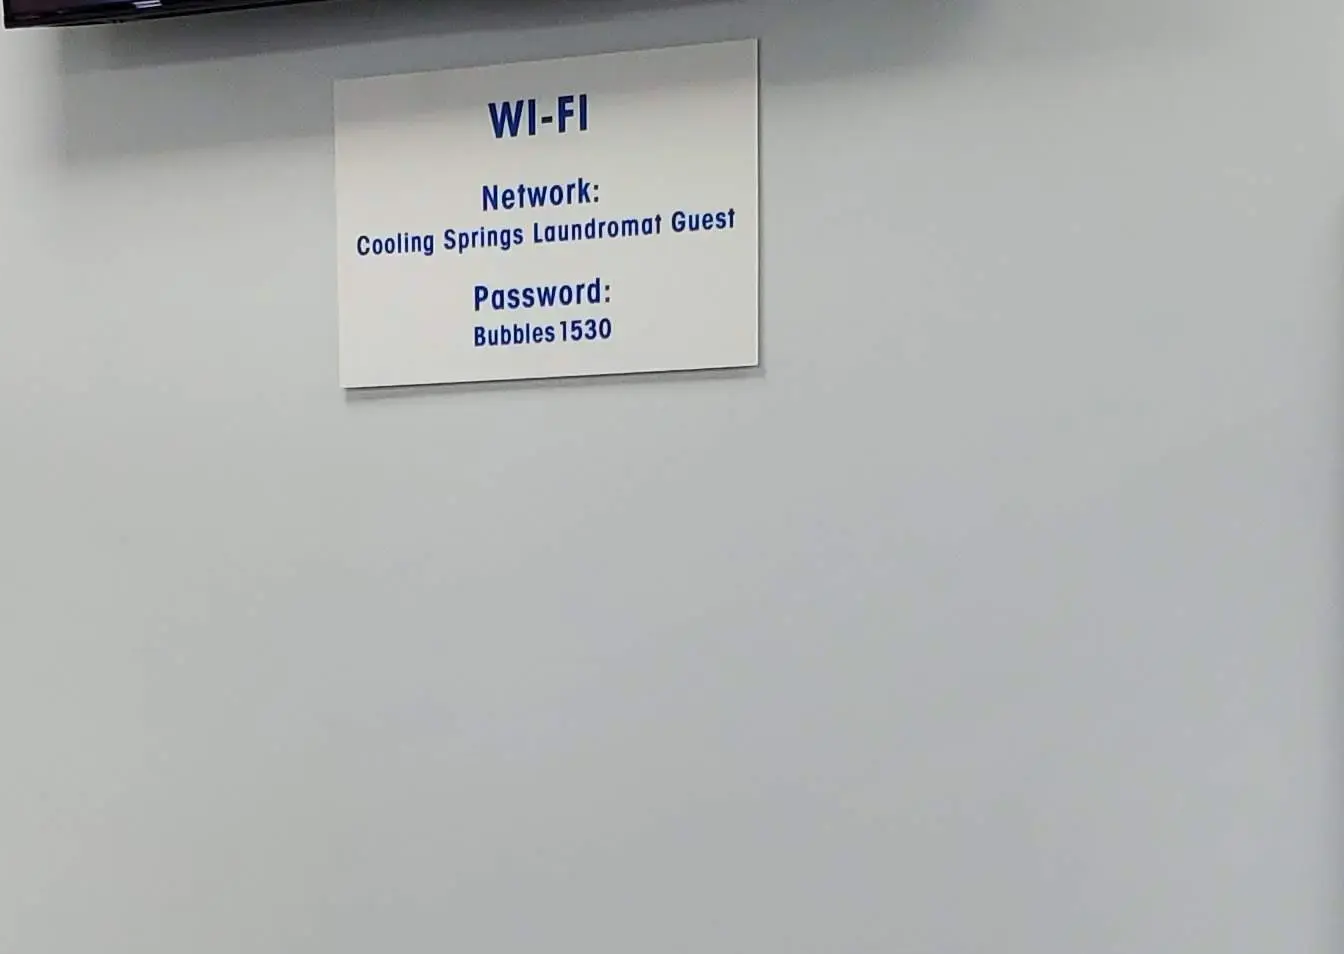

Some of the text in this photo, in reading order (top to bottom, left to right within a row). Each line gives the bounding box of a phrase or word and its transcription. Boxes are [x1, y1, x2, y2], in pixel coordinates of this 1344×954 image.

[488, 94, 589, 138] WI-FI
[482, 178, 600, 211] Network:
[356, 208, 736, 256] Cooling Springs Laundromat Guest
[473, 277, 611, 311] Password:
